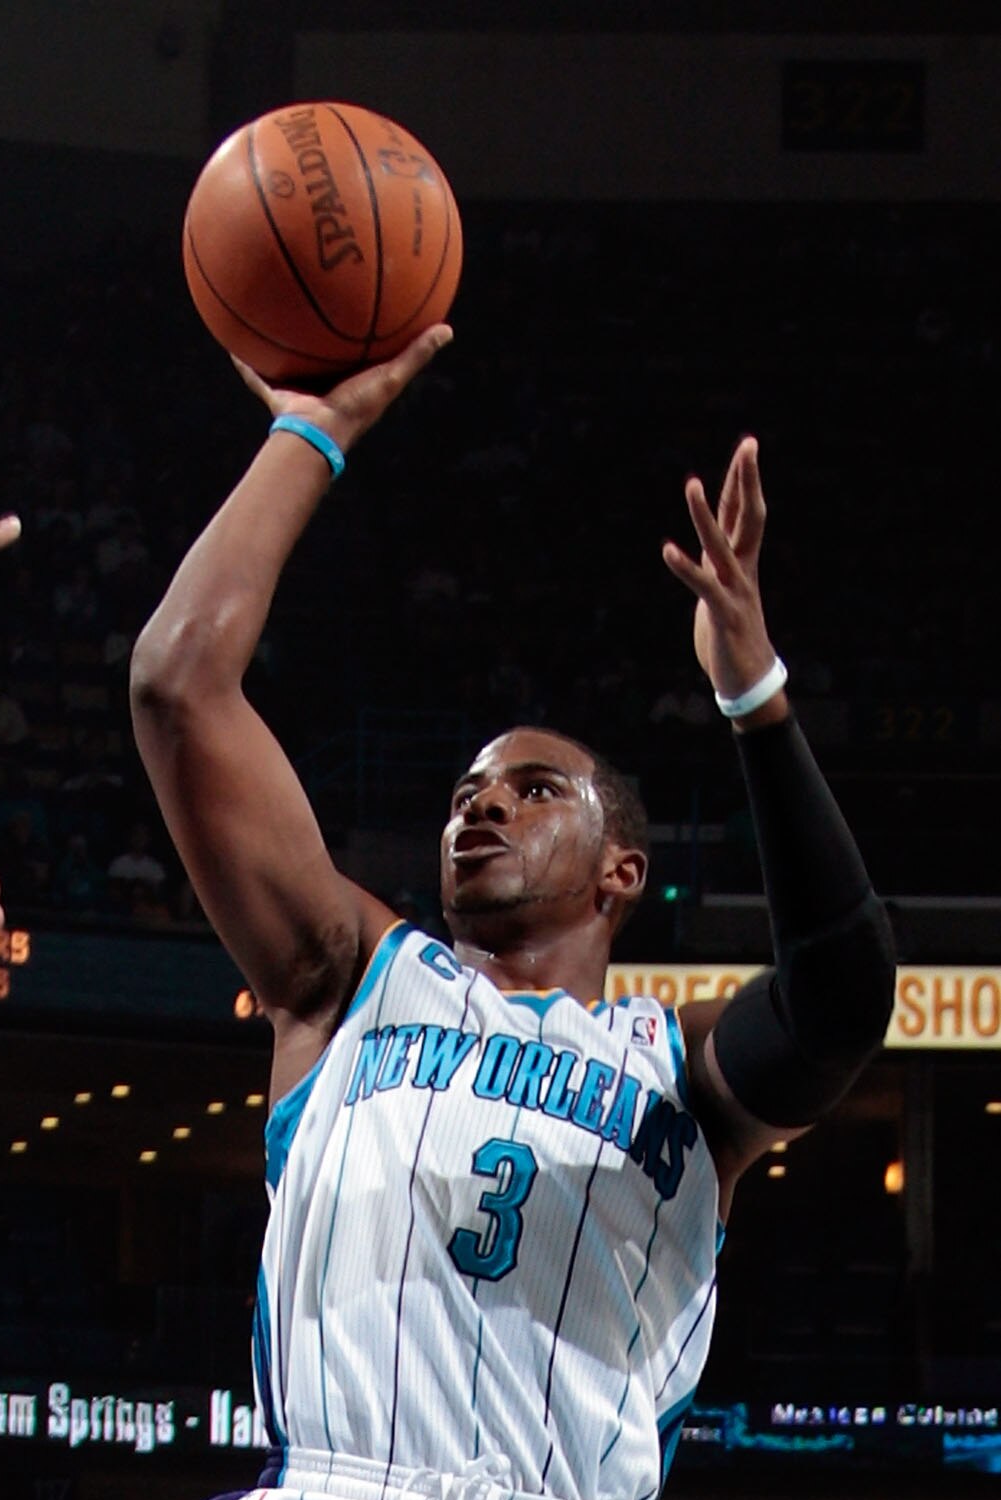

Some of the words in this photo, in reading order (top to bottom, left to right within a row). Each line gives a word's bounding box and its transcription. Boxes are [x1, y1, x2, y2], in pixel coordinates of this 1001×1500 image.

[274, 108, 365, 271] SPALDING
[345, 1023, 480, 1107] NEW
[472, 1033, 699, 1200] ORLEANS
[447, 1137, 539, 1283] 3
[47, 1382, 176, 1453] Springs
